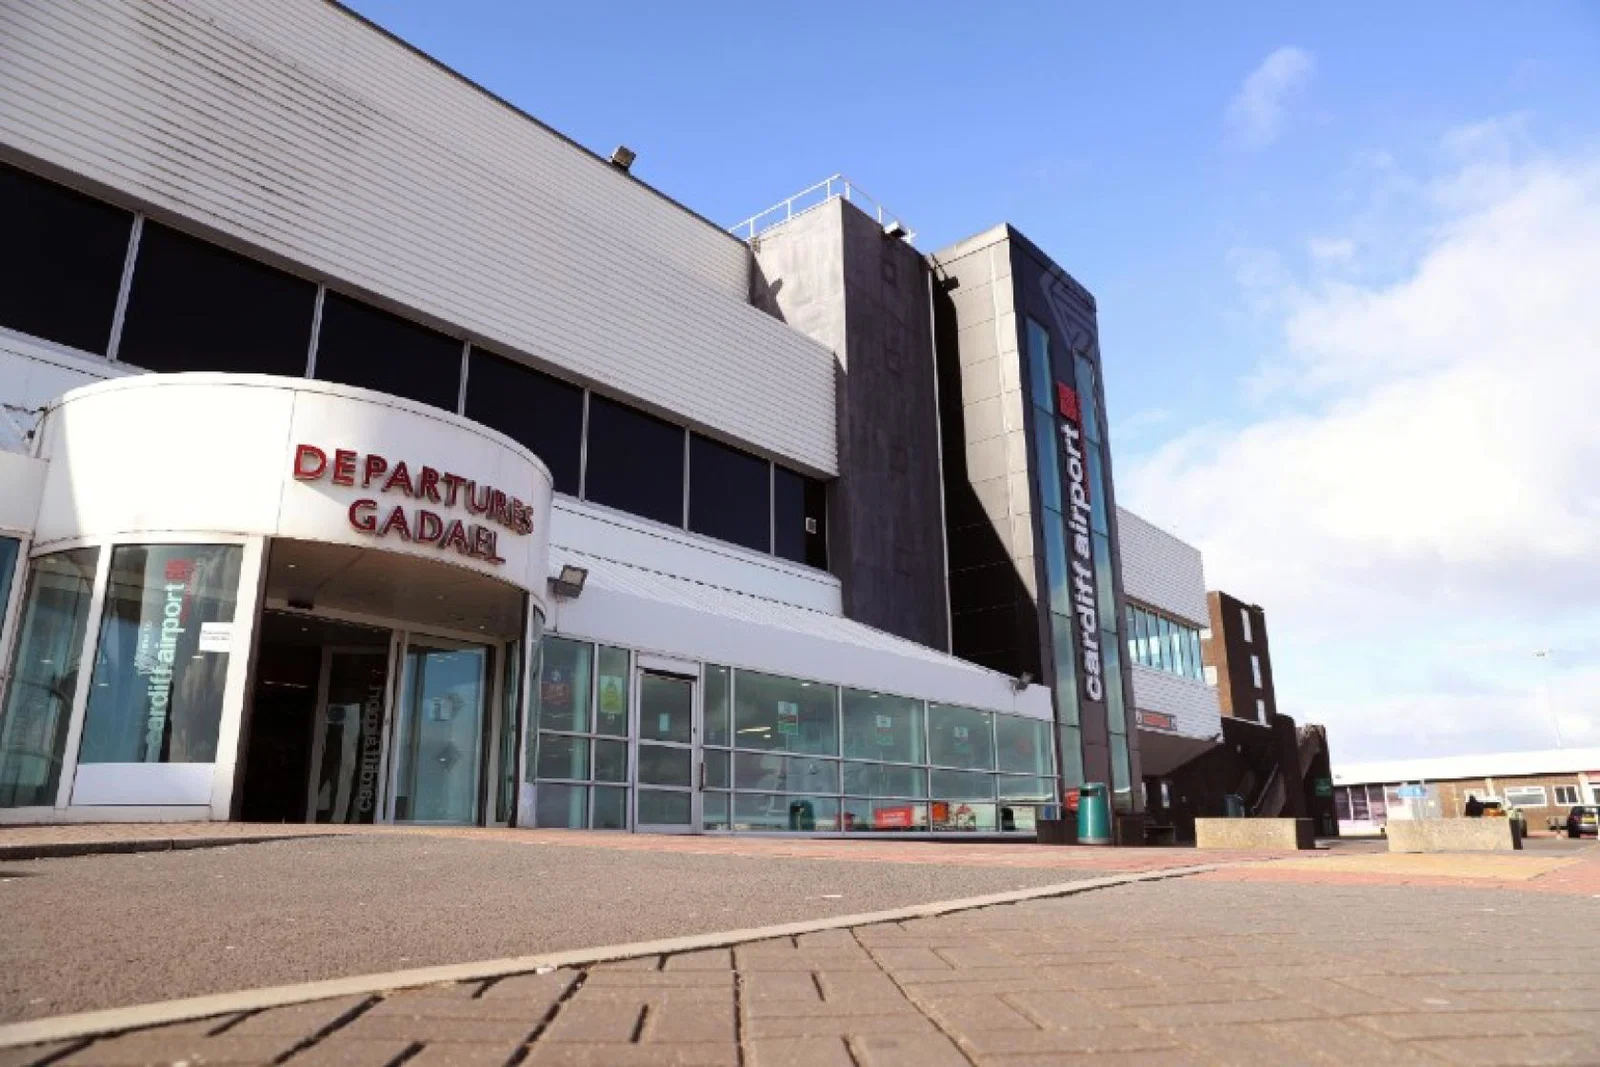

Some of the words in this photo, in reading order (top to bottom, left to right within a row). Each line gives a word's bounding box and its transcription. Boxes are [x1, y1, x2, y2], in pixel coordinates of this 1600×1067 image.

[294, 443, 534, 536] DEPARTURES
[349, 499, 507, 565] GADAEL
[1061, 424, 1091, 559] airport
[157, 583, 186, 664] airport
[1072, 560, 1102, 701] cardiff
